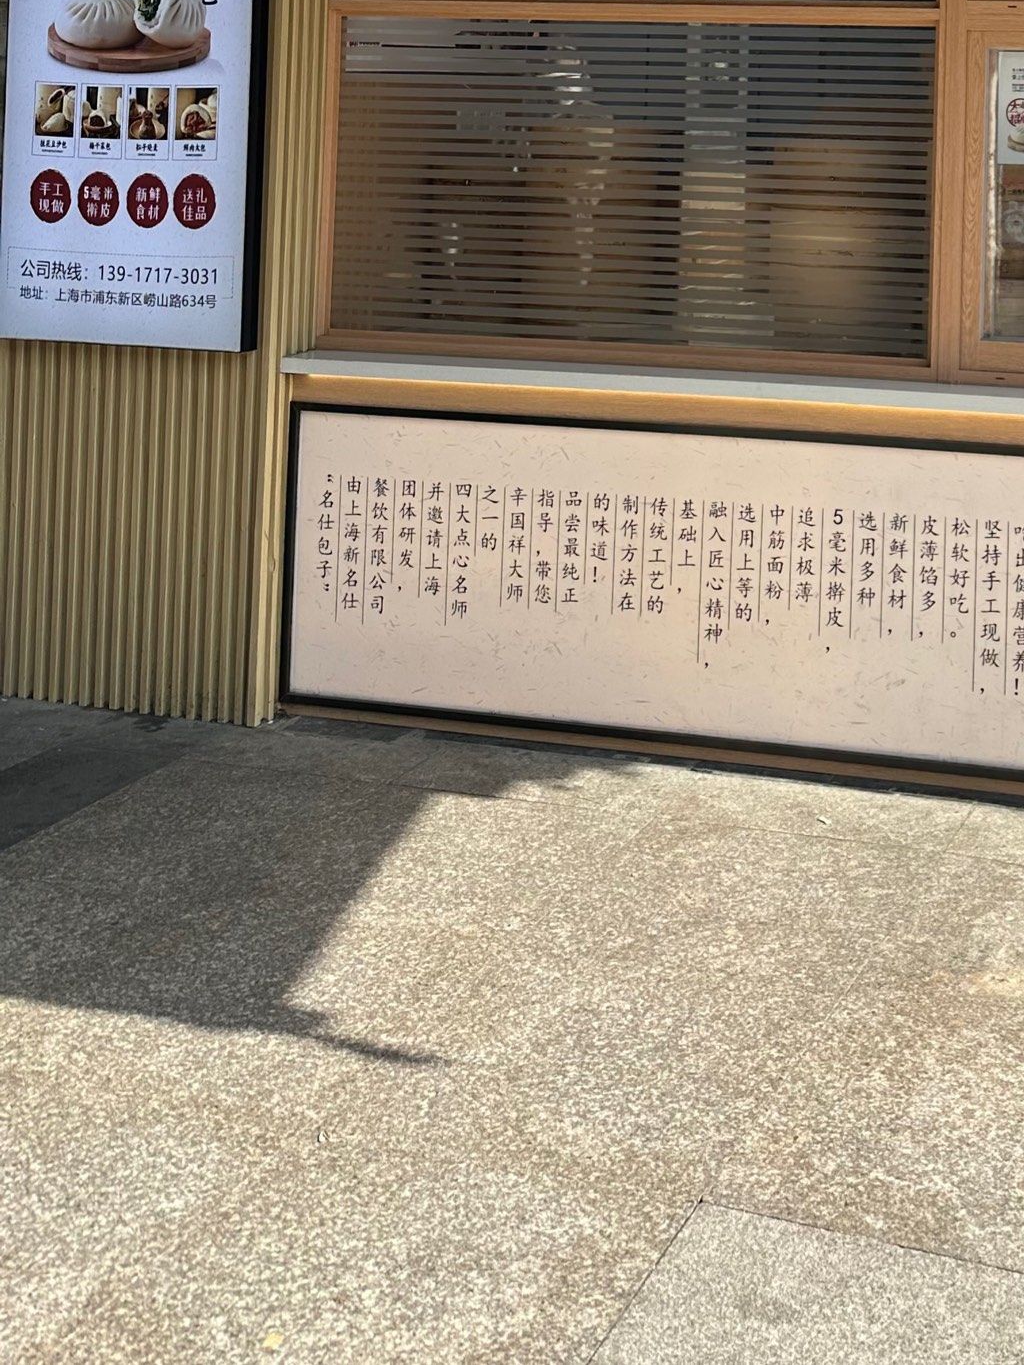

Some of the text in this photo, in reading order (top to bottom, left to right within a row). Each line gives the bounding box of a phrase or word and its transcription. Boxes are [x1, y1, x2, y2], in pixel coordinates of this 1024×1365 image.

[39, 182, 63, 196] 手工
[39, 198, 64, 213] 现做
[84, 186, 113, 201] 5毫米
[136, 187, 161, 202] 新鲜
[136, 204, 160, 220] 食材
[182, 206, 206, 221] 佳品
[183, 188, 207, 203] 送礼
[341, 476, 361, 609] 由上海新名仕
[369, 478, 390, 614] 餐饮有限公司
[398, 480, 416, 591] 团体研发，
[425, 482, 444, 595] 并邀请上海
[451, 483, 472, 619] 四大点心名师
[480, 486, 499, 551] 之一的
[506, 488, 528, 601] 辛国祥大师
[534, 489, 555, 604] 指导，带您
[561, 492, 583, 605] 品尝最纯正
[590, 493, 610, 584] 的味道！
[618, 495, 639, 613] 制作方法在
[646, 497, 668, 614] 传统工艺的
[677, 500, 697, 595] 基础上，
[734, 504, 756, 622] 选用上等的
[763, 505, 785, 626] 中筋面粉，
[795, 508, 816, 602] 追求极薄
[857, 512, 877, 608] 选用多种
[887, 513, 909, 637] 新鲜食材，
[704, 501, 727, 669] 融入匠心精神，
[825, 509, 846, 654] 5毫米擀皮，
[918, 515, 939, 639] 皮薄馅多，
[949, 517, 971, 639] 松软好吃。
[979, 519, 1002, 695] 坚持手工现做，
